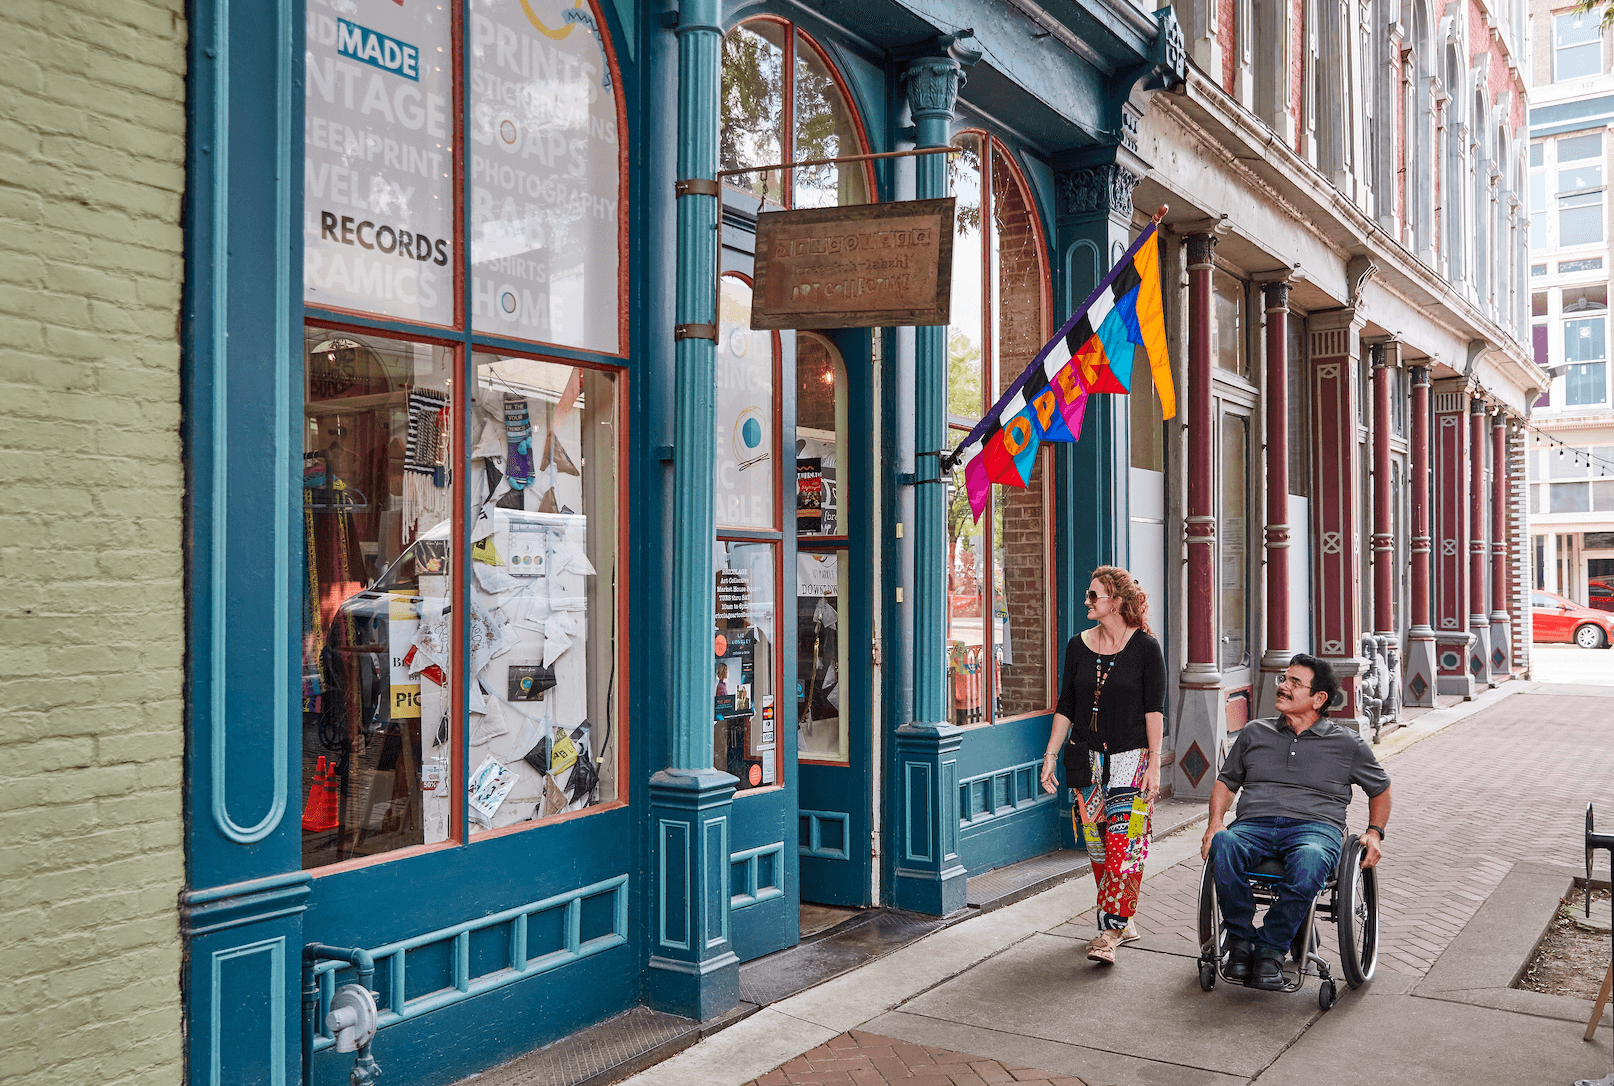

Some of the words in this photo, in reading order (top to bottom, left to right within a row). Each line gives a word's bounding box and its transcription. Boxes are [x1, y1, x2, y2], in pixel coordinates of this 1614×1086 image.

[338, 21, 417, 78] MADE
[472, 102, 587, 177] SOAPS
[321, 210, 449, 267] RECORDS
